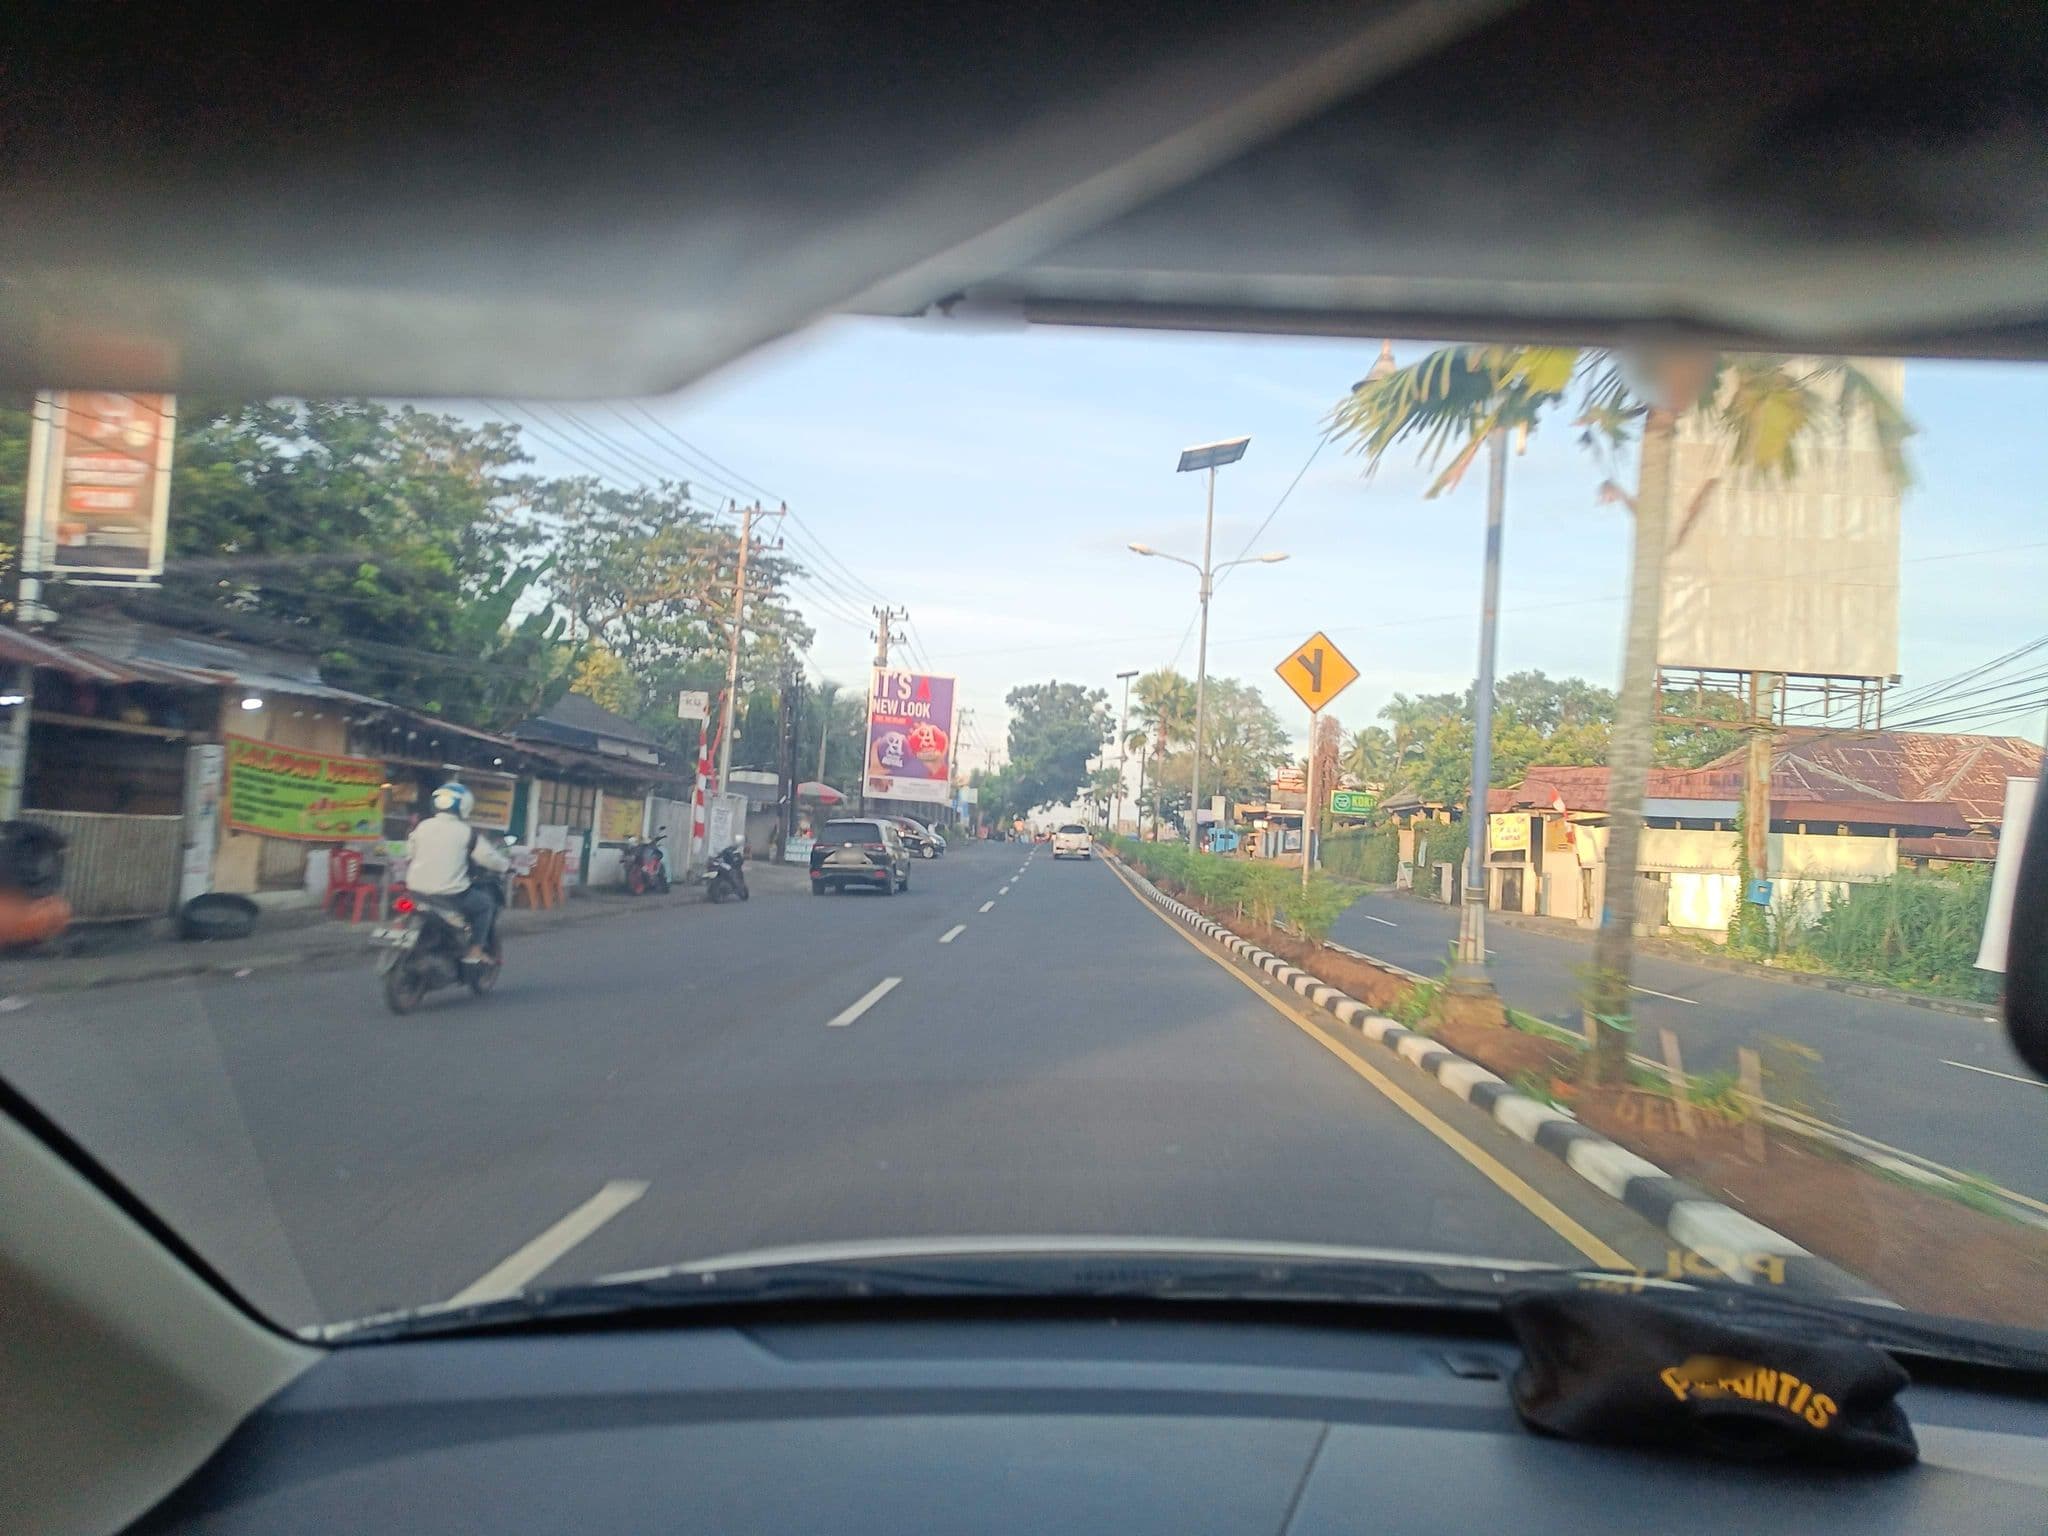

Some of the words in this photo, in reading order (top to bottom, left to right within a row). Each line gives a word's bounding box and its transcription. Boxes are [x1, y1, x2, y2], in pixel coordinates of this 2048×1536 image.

[874, 671, 912, 700] IT'S
[918, 677, 931, 702] A
[873, 698, 899, 715] NEW
[901, 701, 931, 719] LOOK
[1660, 1364, 1838, 1429] PINTIS
